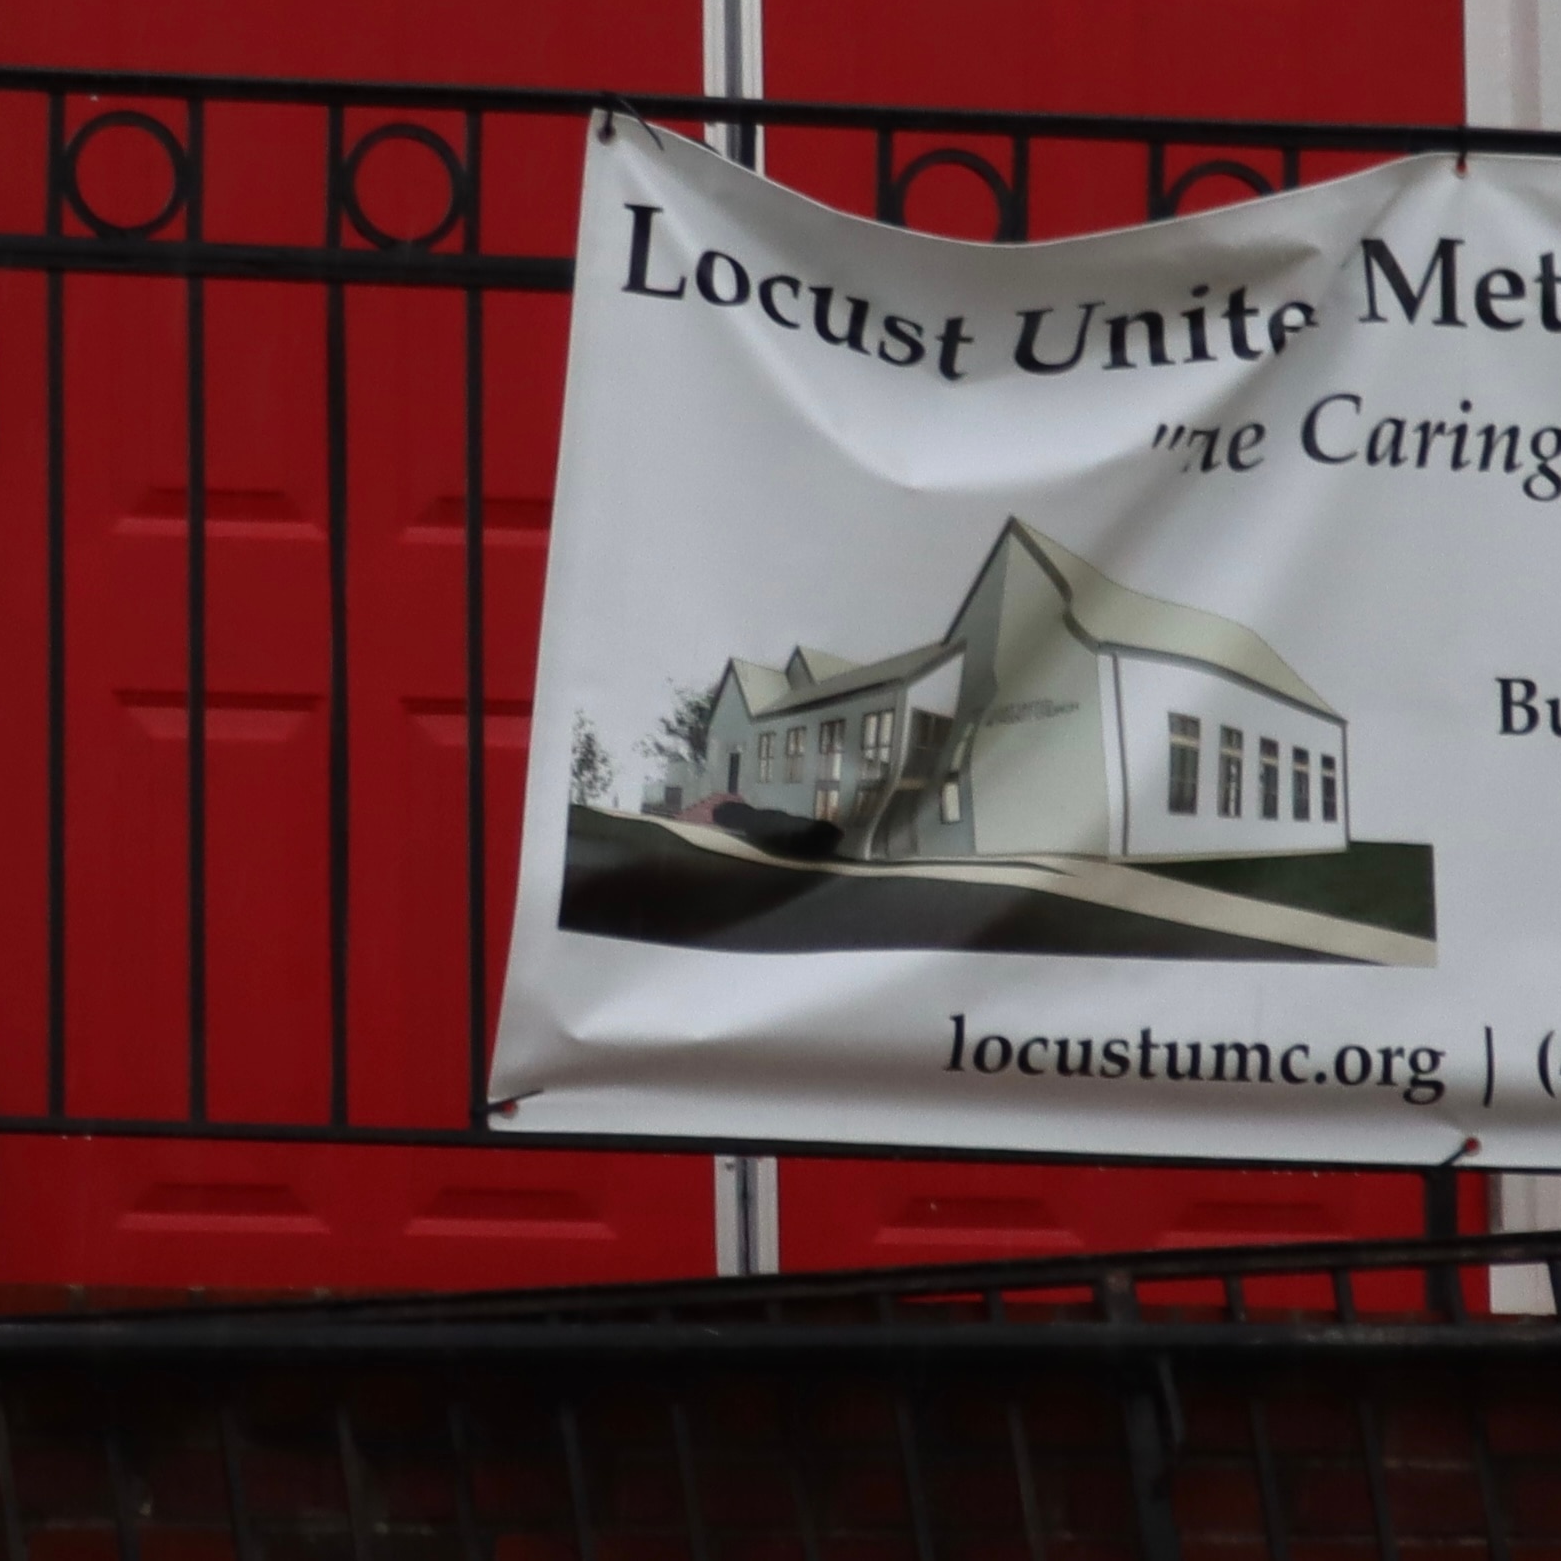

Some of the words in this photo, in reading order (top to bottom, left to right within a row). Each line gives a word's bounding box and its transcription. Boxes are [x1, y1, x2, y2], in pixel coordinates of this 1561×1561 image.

[621, 202, 976, 382] Locust
[1012, 283, 1320, 376] Unite
[942, 1013, 1448, 1107] locustumc.org
